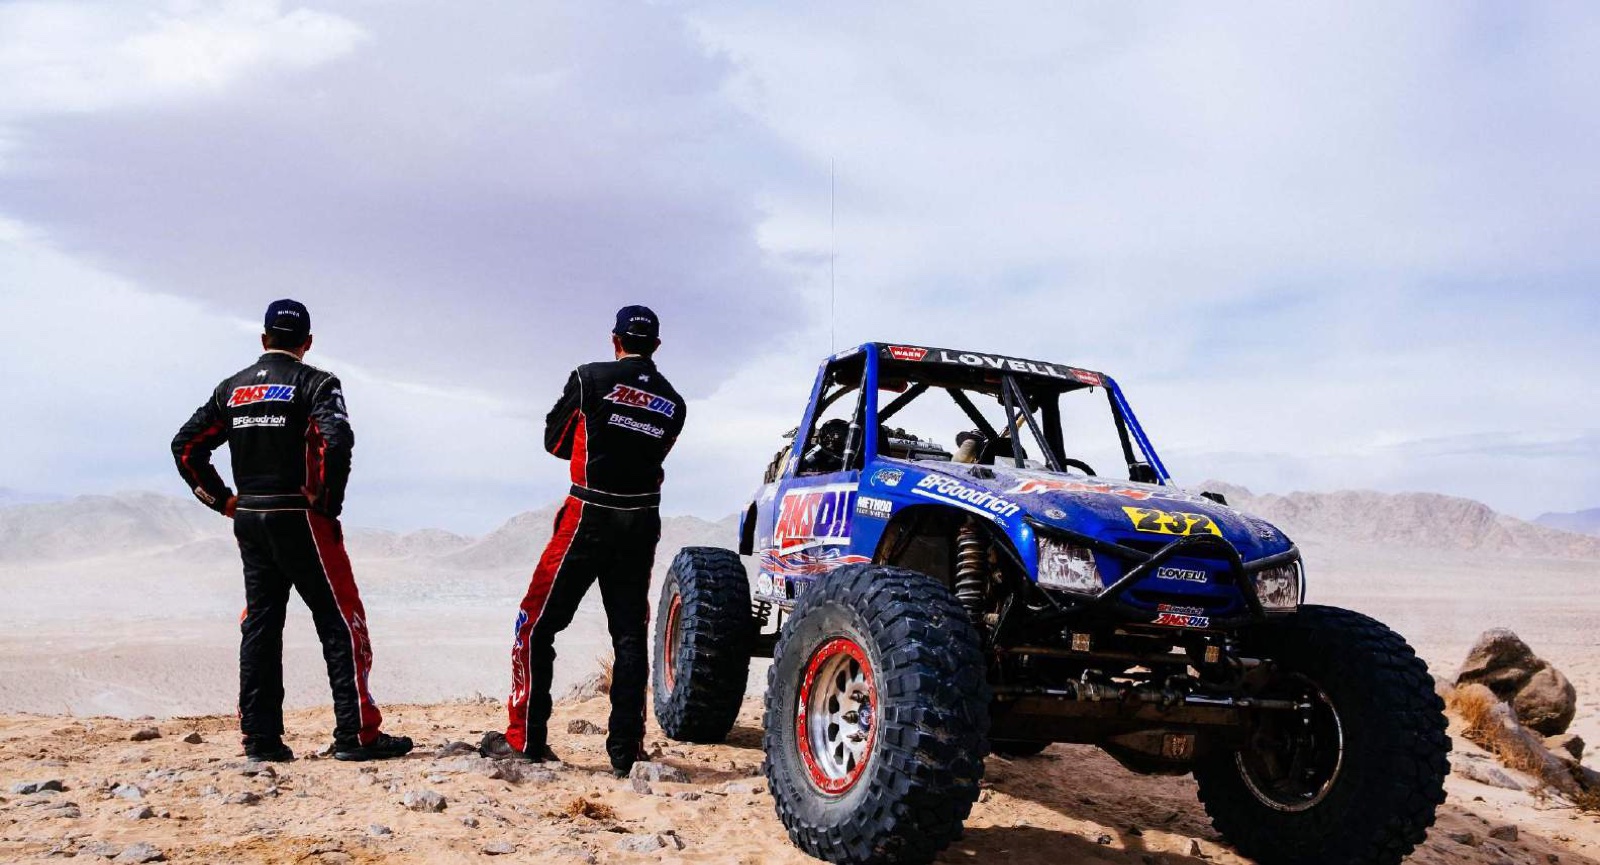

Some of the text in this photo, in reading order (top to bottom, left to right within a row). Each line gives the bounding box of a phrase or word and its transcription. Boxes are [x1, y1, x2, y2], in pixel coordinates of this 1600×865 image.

[894, 350, 921, 358] WARN
[939, 350, 1066, 379] LOVELL
[227, 384, 296, 407] AMSOIL
[603, 384, 676, 418] AMSOIL
[233, 415, 286, 426] BFGoodrich
[610, 414, 665, 436] BFGoodrich
[857, 496, 892, 512] METHOD
[917, 474, 1020, 517] BFGoodrich
[1136, 508, 1212, 535] 232
[1157, 567, 1207, 583] LOVELL
[1151, 613, 1209, 628] AMSOIL
